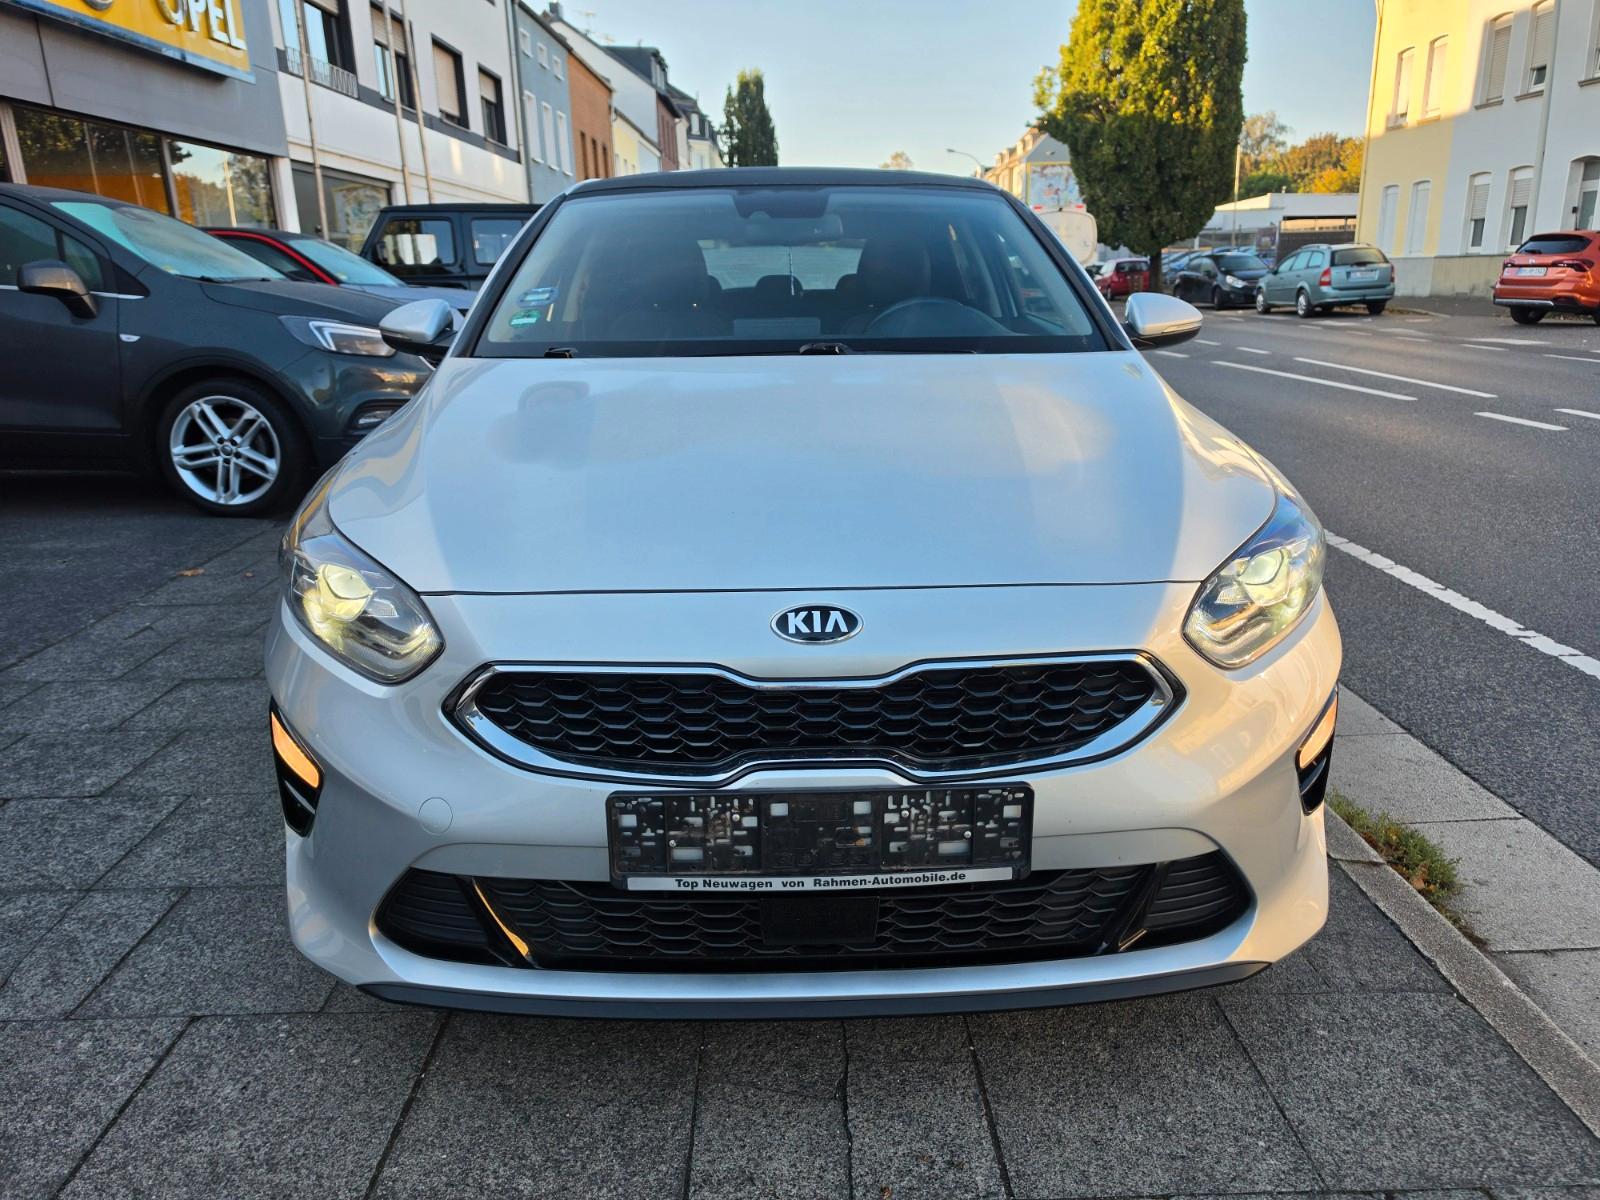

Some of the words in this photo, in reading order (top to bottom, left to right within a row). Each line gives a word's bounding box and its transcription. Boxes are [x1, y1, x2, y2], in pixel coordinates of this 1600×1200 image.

[786, 610, 849, 634] KIA
[675, 879, 699, 890] Top
[702, 879, 773, 890] Neuwagen
[781, 880, 805, 888] von
[813, 872, 966, 887] Rahmen-Automobile.de
